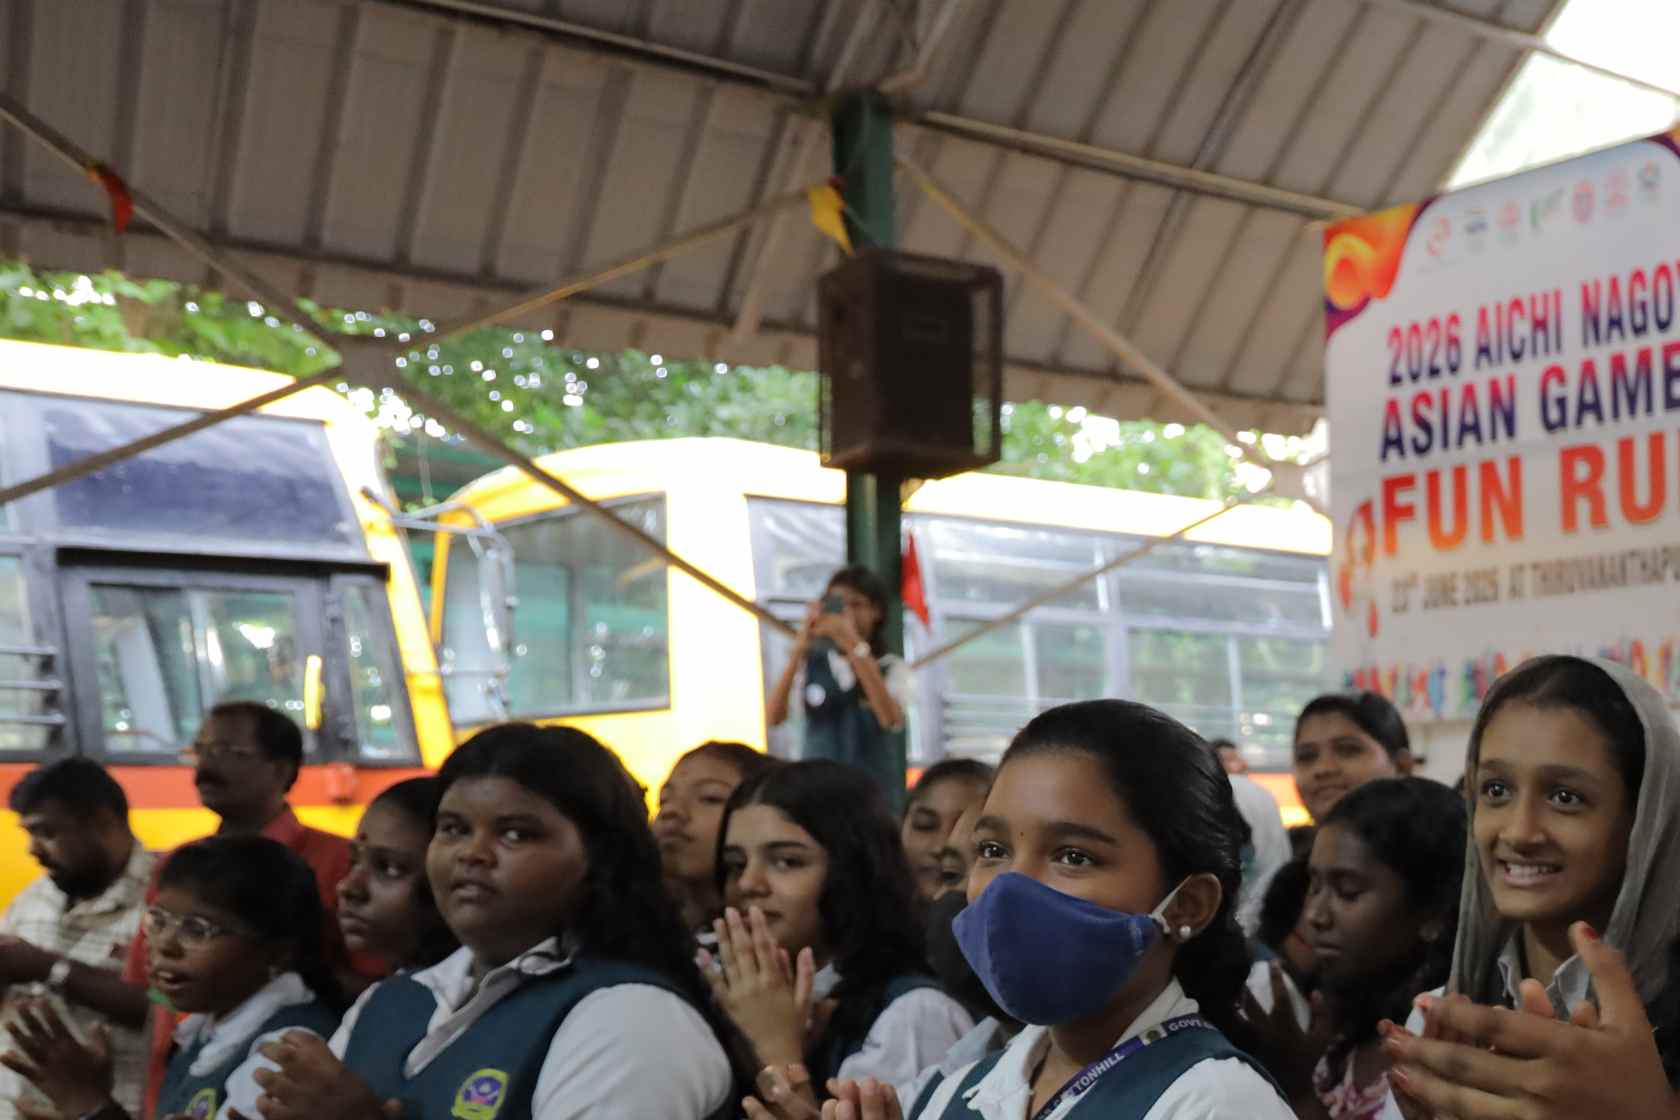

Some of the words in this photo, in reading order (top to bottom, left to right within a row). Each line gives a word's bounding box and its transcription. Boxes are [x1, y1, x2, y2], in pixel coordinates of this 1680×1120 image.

[1387, 313, 1462, 386] 2026
[1475, 288, 1562, 371] AICHI
[1380, 374, 1516, 462] ASIAN
[1381, 455, 1523, 557] FUN
